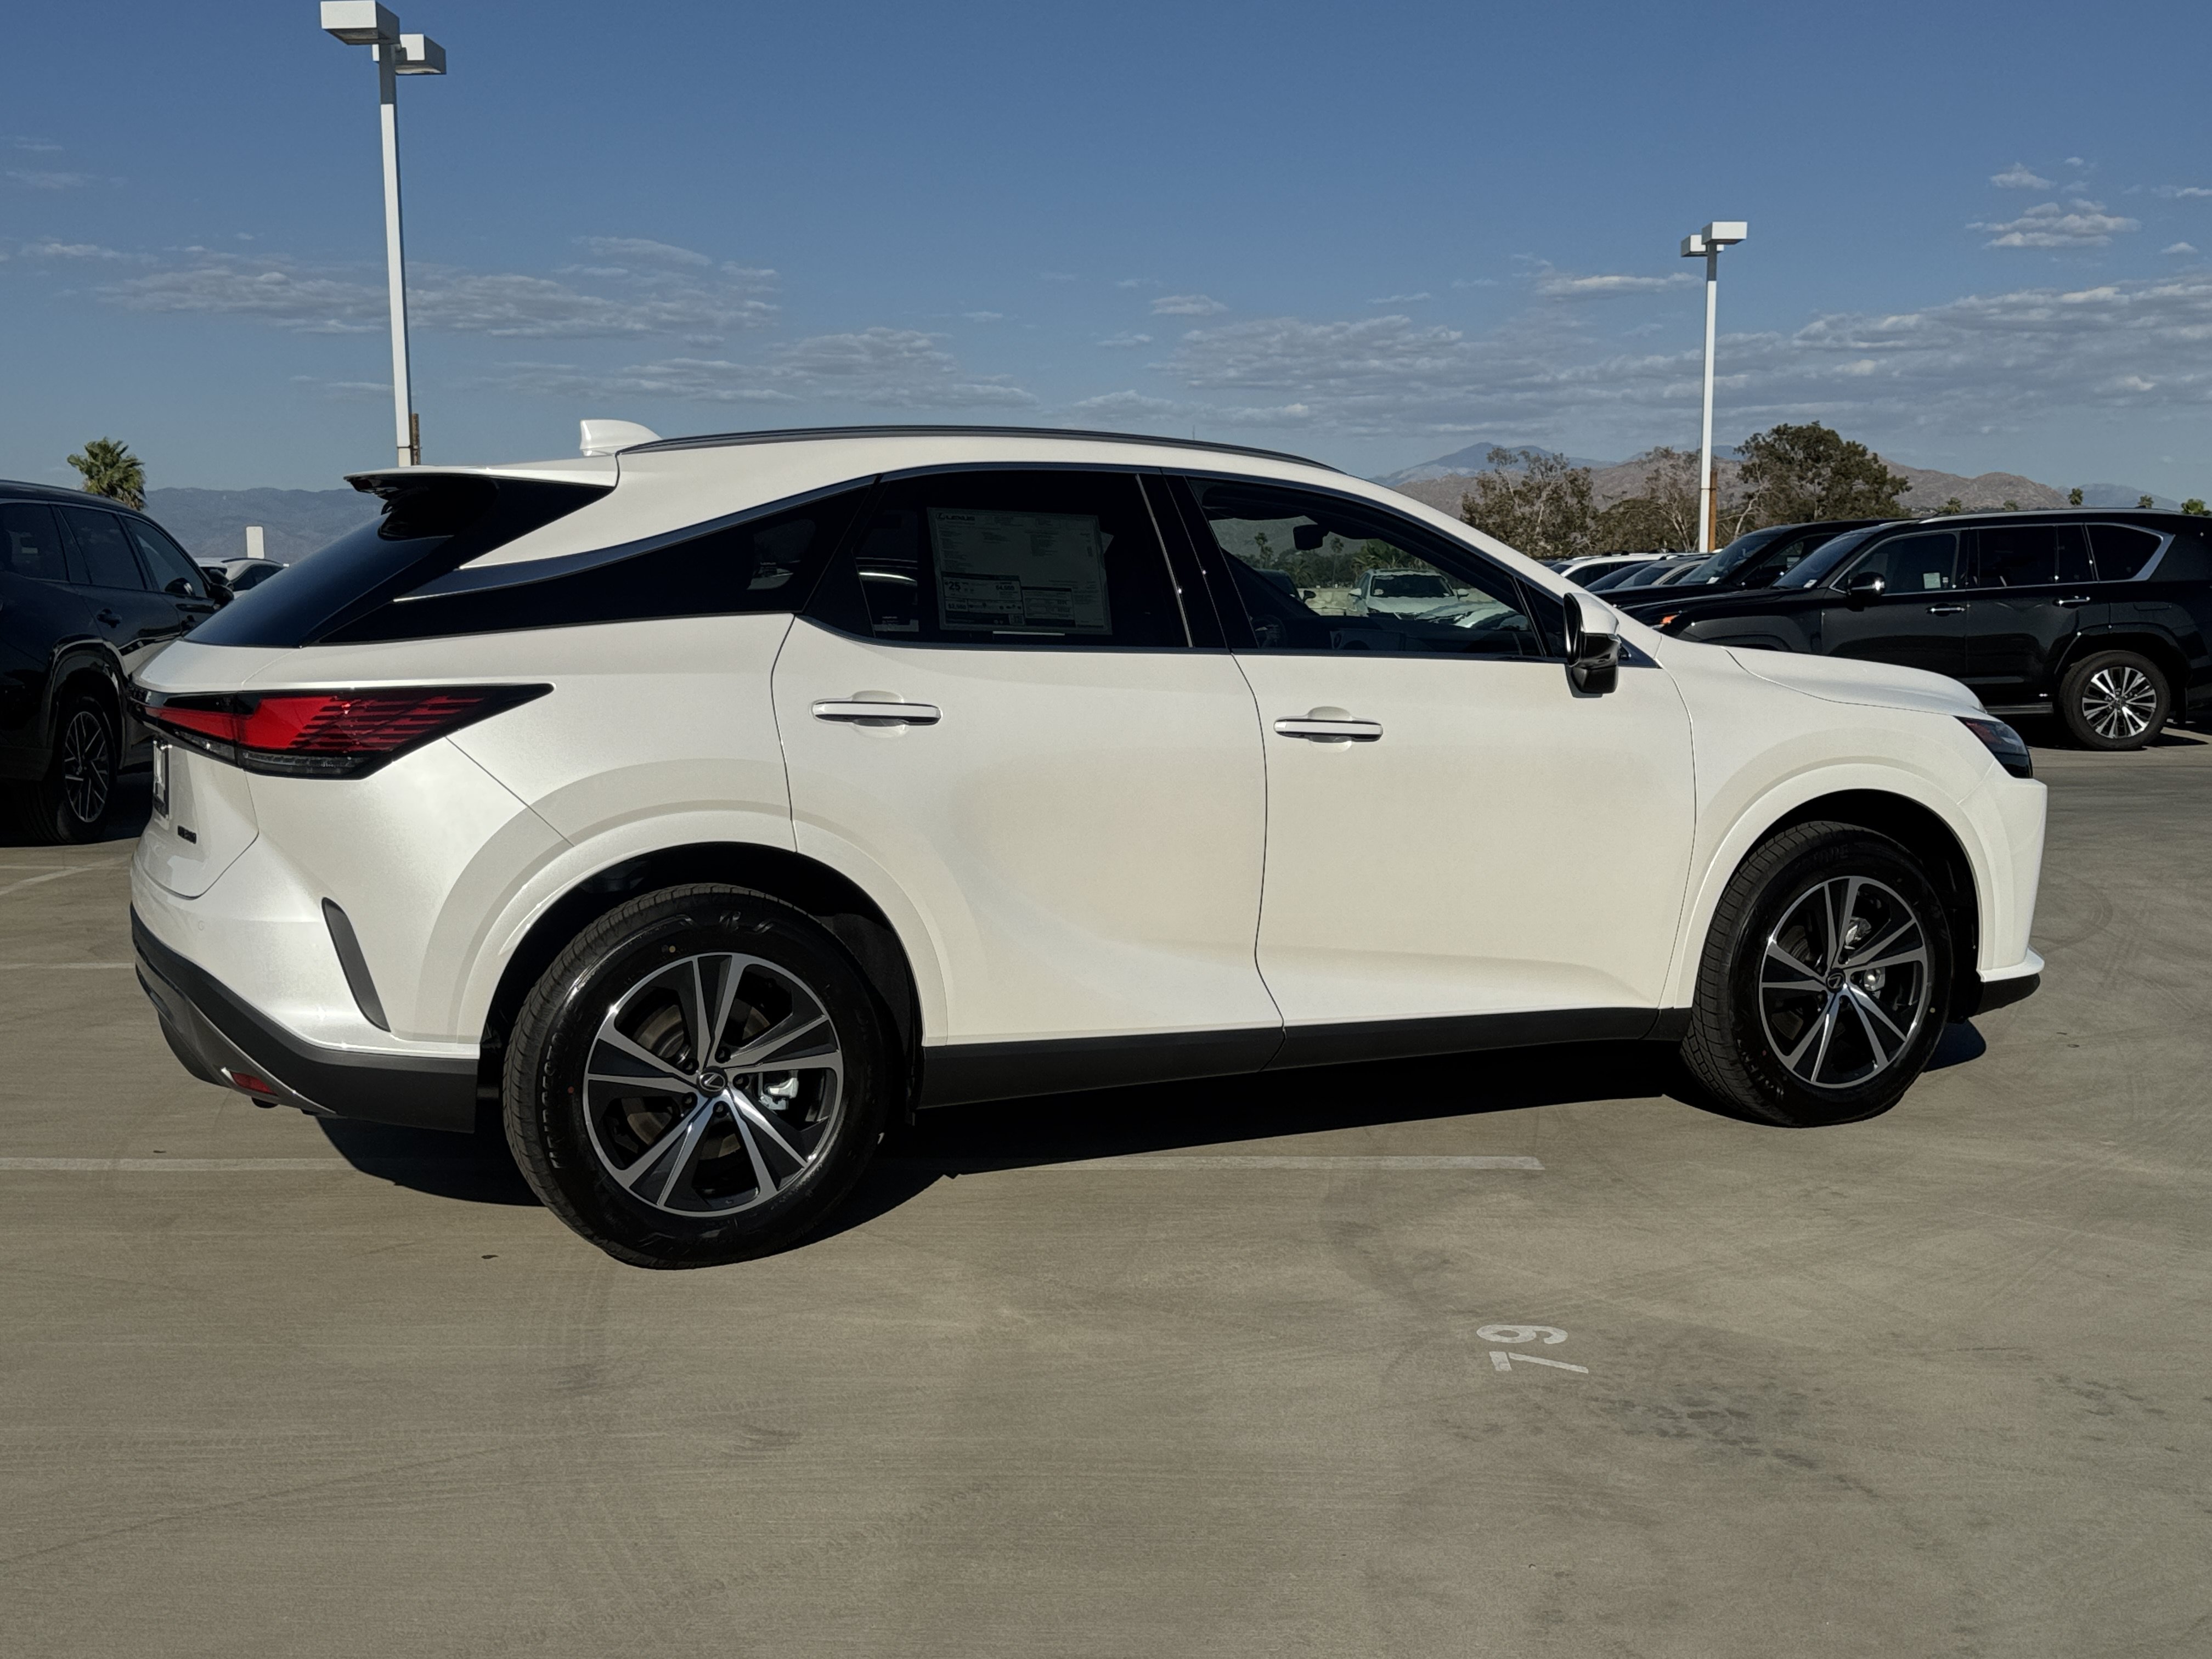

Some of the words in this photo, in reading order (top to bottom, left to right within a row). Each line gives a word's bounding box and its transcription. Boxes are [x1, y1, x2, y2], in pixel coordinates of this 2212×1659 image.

[949, 581, 961, 590] 25
[540, 1007, 573, 1169] BRIDGESTO
[1476, 1324, 1589, 1373] 79
